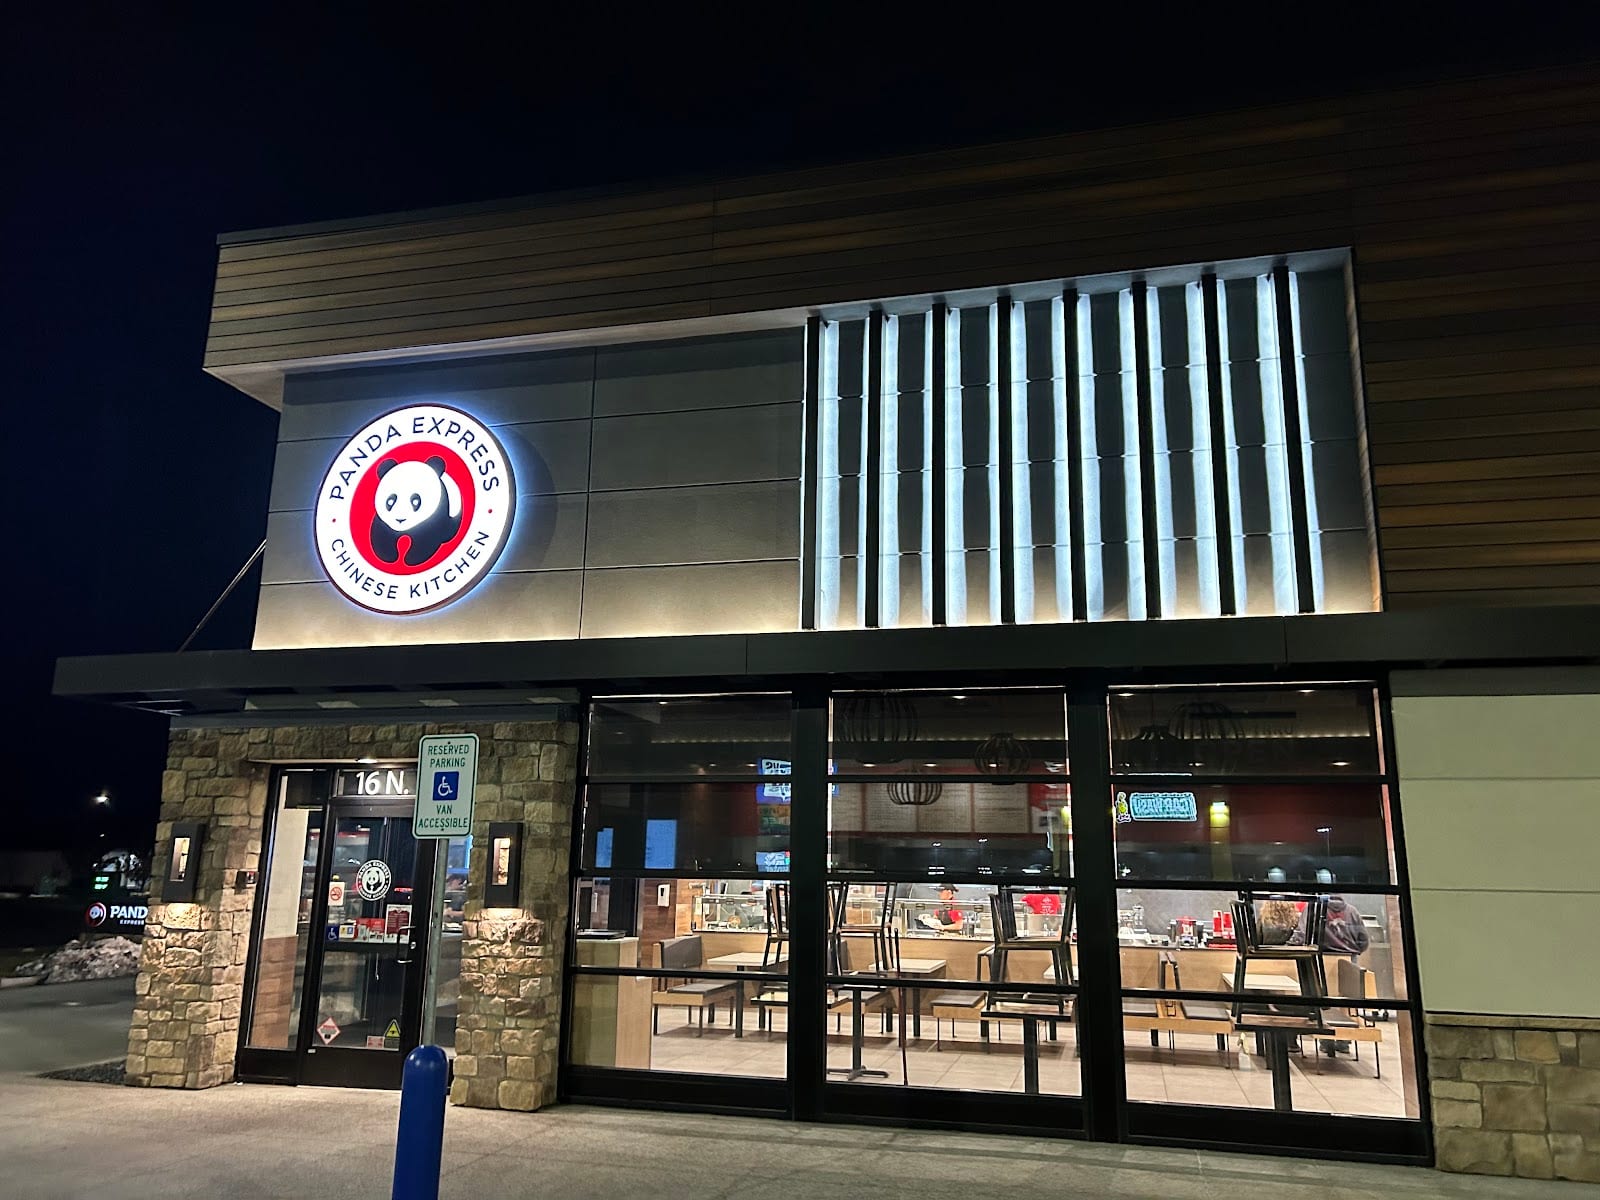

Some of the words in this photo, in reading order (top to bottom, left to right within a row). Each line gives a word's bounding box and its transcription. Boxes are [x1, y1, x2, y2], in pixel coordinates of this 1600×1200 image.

[329, 424, 402, 500] PANDA
[412, 416, 500, 492] EXPRESS
[331, 538, 399, 600] CHINESE
[409, 530, 490, 599] KITCHEN
[427, 744, 470, 756] RESERVED
[429, 757, 466, 768] PARKING
[356, 770, 380, 795] 16
[385, 770, 409, 795] N.
[436, 804, 453, 815] VAN
[417, 817, 469, 829] ACCESSIBLE
[110, 905, 148, 919] PAND
